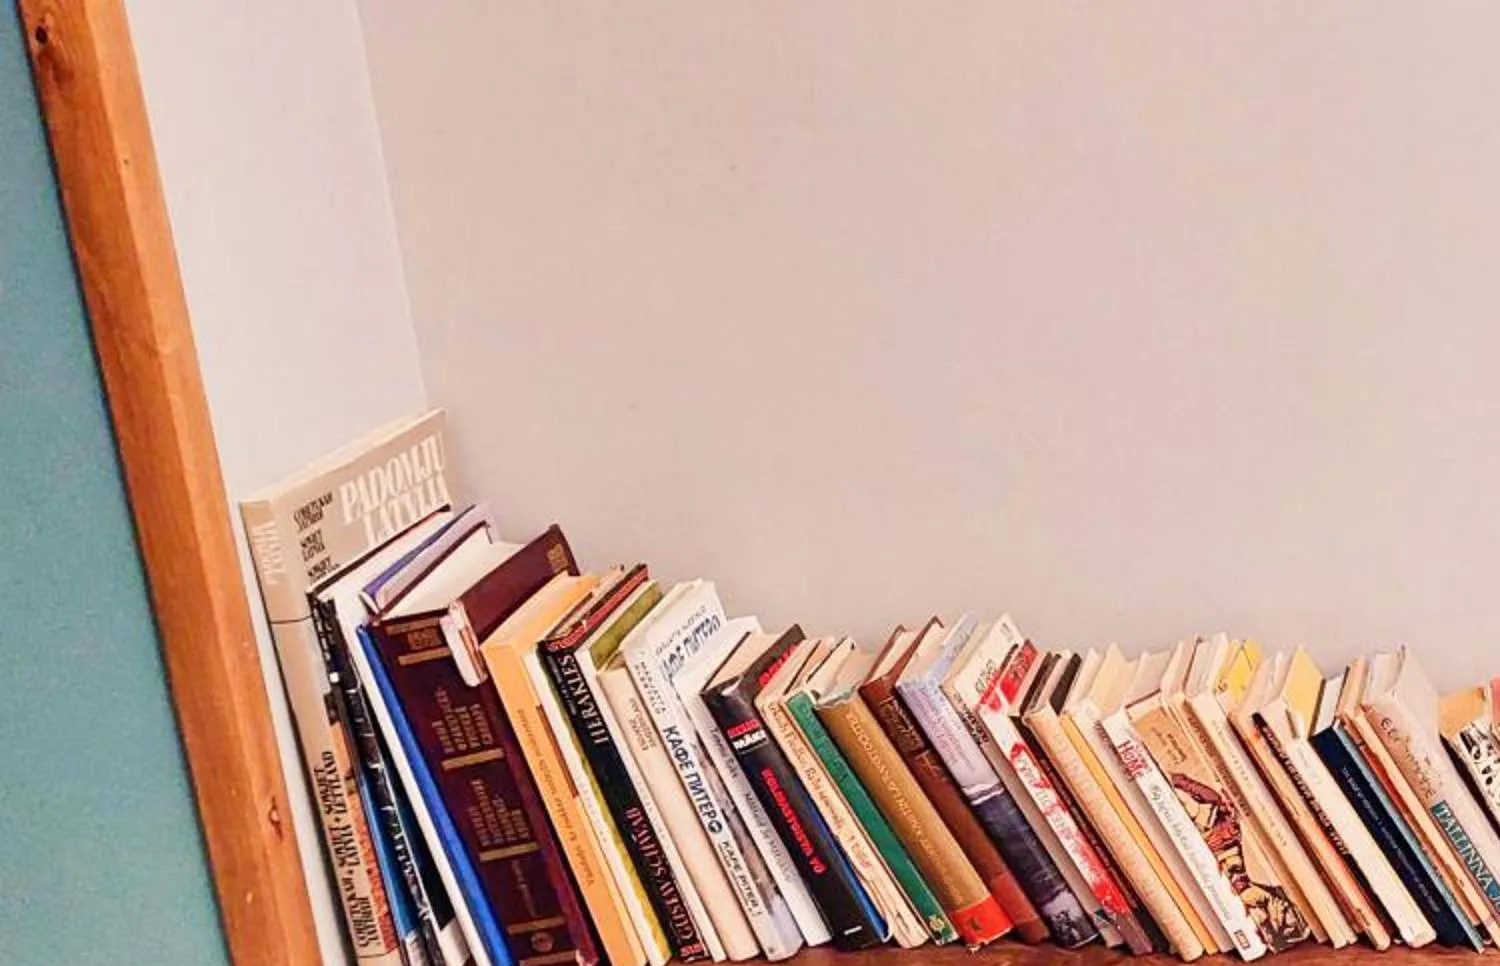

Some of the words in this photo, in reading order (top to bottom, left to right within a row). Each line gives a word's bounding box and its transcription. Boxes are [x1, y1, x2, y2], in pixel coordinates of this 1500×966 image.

[339, 432, 446, 526] PADOMJU
[556, 652, 608, 745] HERAKLES
[662, 724, 695, 772] КАФЕ
[1433, 803, 1494, 889] TALLINNA
